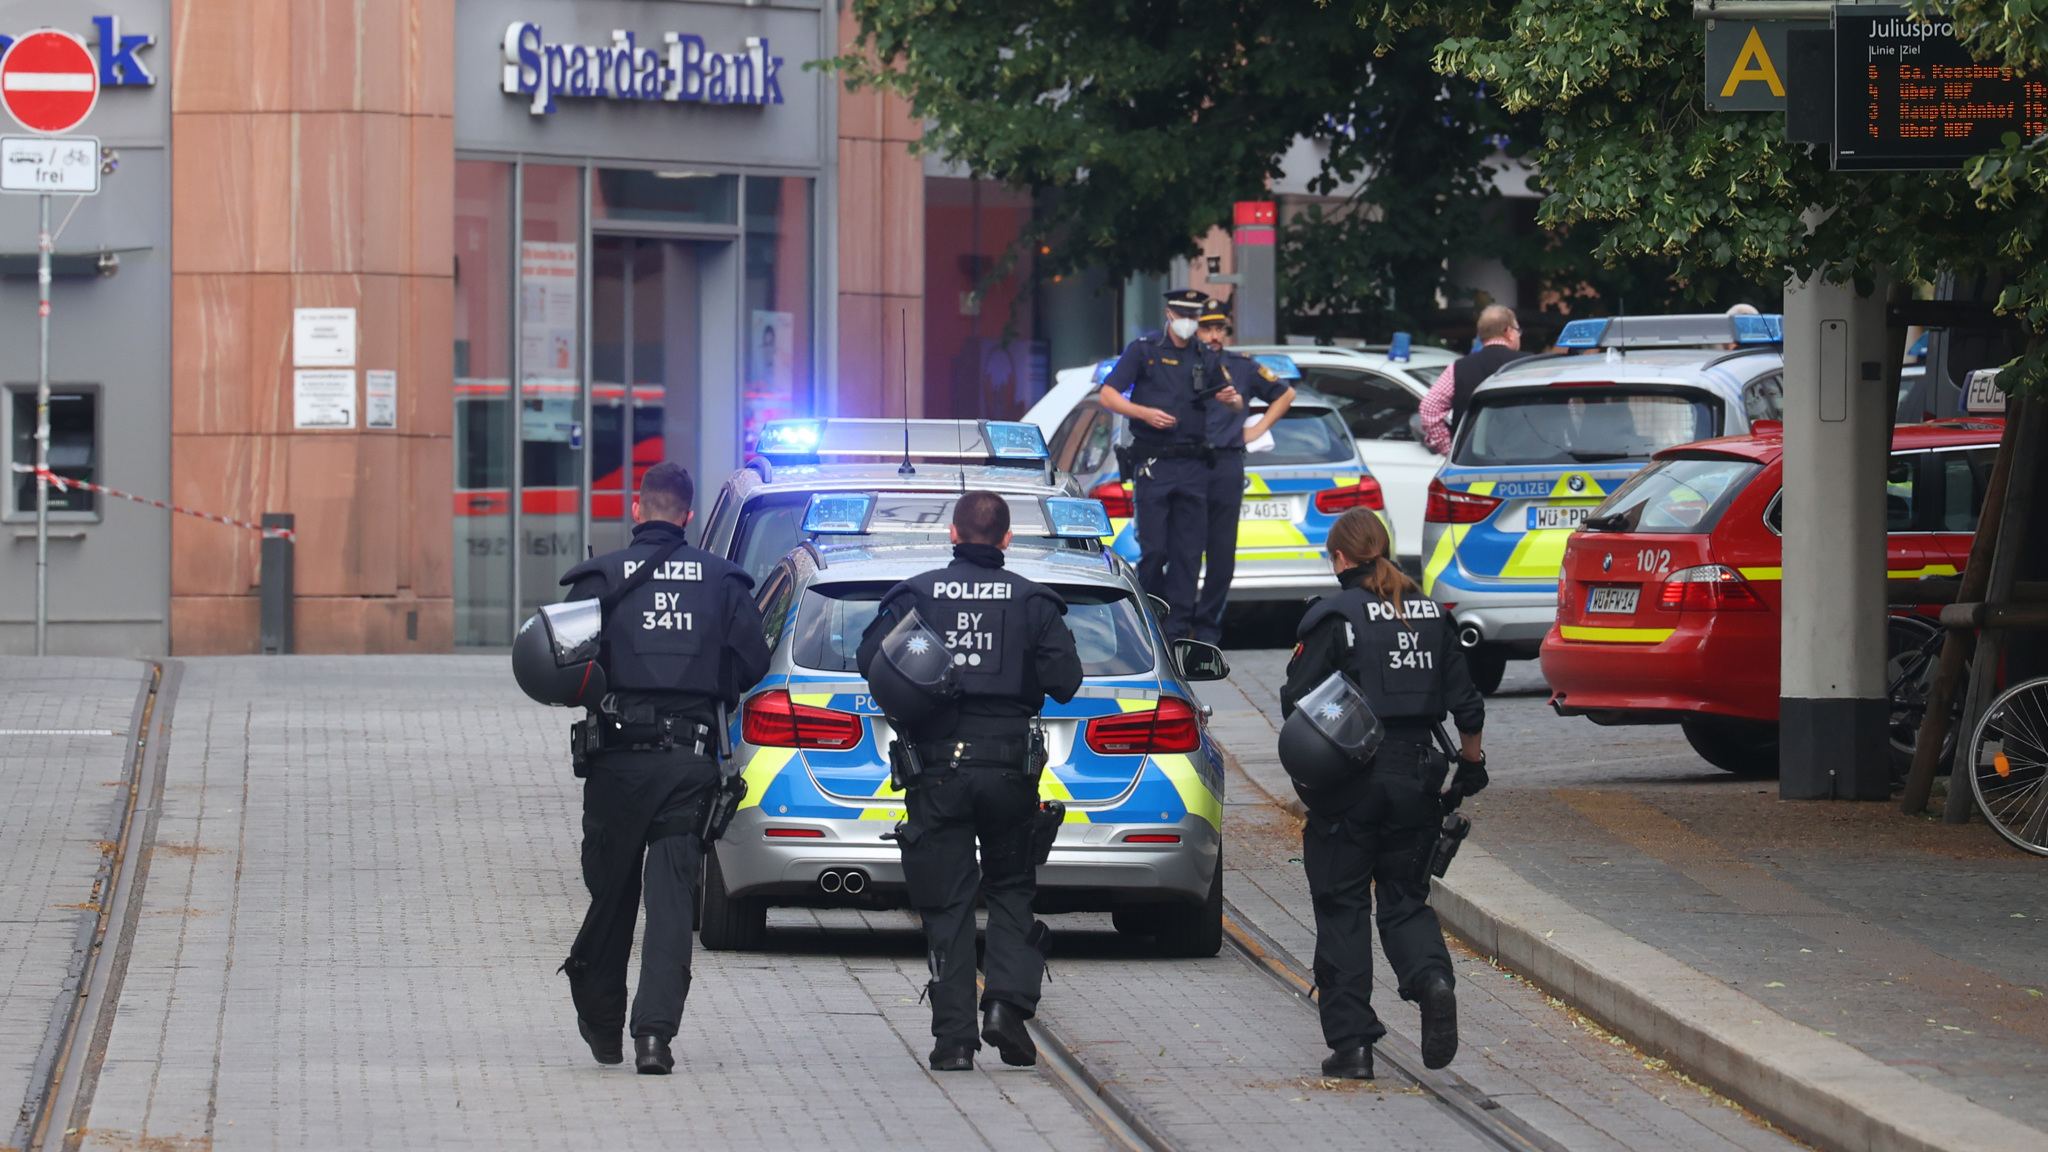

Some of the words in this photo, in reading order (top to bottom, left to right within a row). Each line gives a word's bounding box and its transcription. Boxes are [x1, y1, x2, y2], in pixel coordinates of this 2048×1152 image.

[1869, 18, 1957, 42] Juliuspro
[1871, 45, 1895, 55] Linie
[1902, 45, 1921, 55] Ziel
[503, 21, 784, 114] Sparda-Bank
[1720, 26, 1786, 97] A
[1932, 63, 2012, 82] Keesburg
[1900, 101, 2014, 122] Hauptbahnhof
[36, 167, 64, 183] frei
[1969, 378, 2005, 403] FEUE
[1498, 482, 1551, 496] POLIZEI
[1254, 503, 1289, 518] 4013
[1537, 508, 1558, 526] WÜ
[623, 559, 703, 581] PLIZEI
[1636, 549, 1671, 574] 10/2
[933, 581, 1012, 600] POLIZEI
[654, 591, 680, 611] BY
[1366, 600, 1440, 621] POLIZEI
[642, 611, 692, 631] 3411
[957, 611, 983, 631] BY
[944, 630, 993, 650] 3411
[1397, 631, 1419, 650] BY
[1388, 650, 1433, 669] 3411
